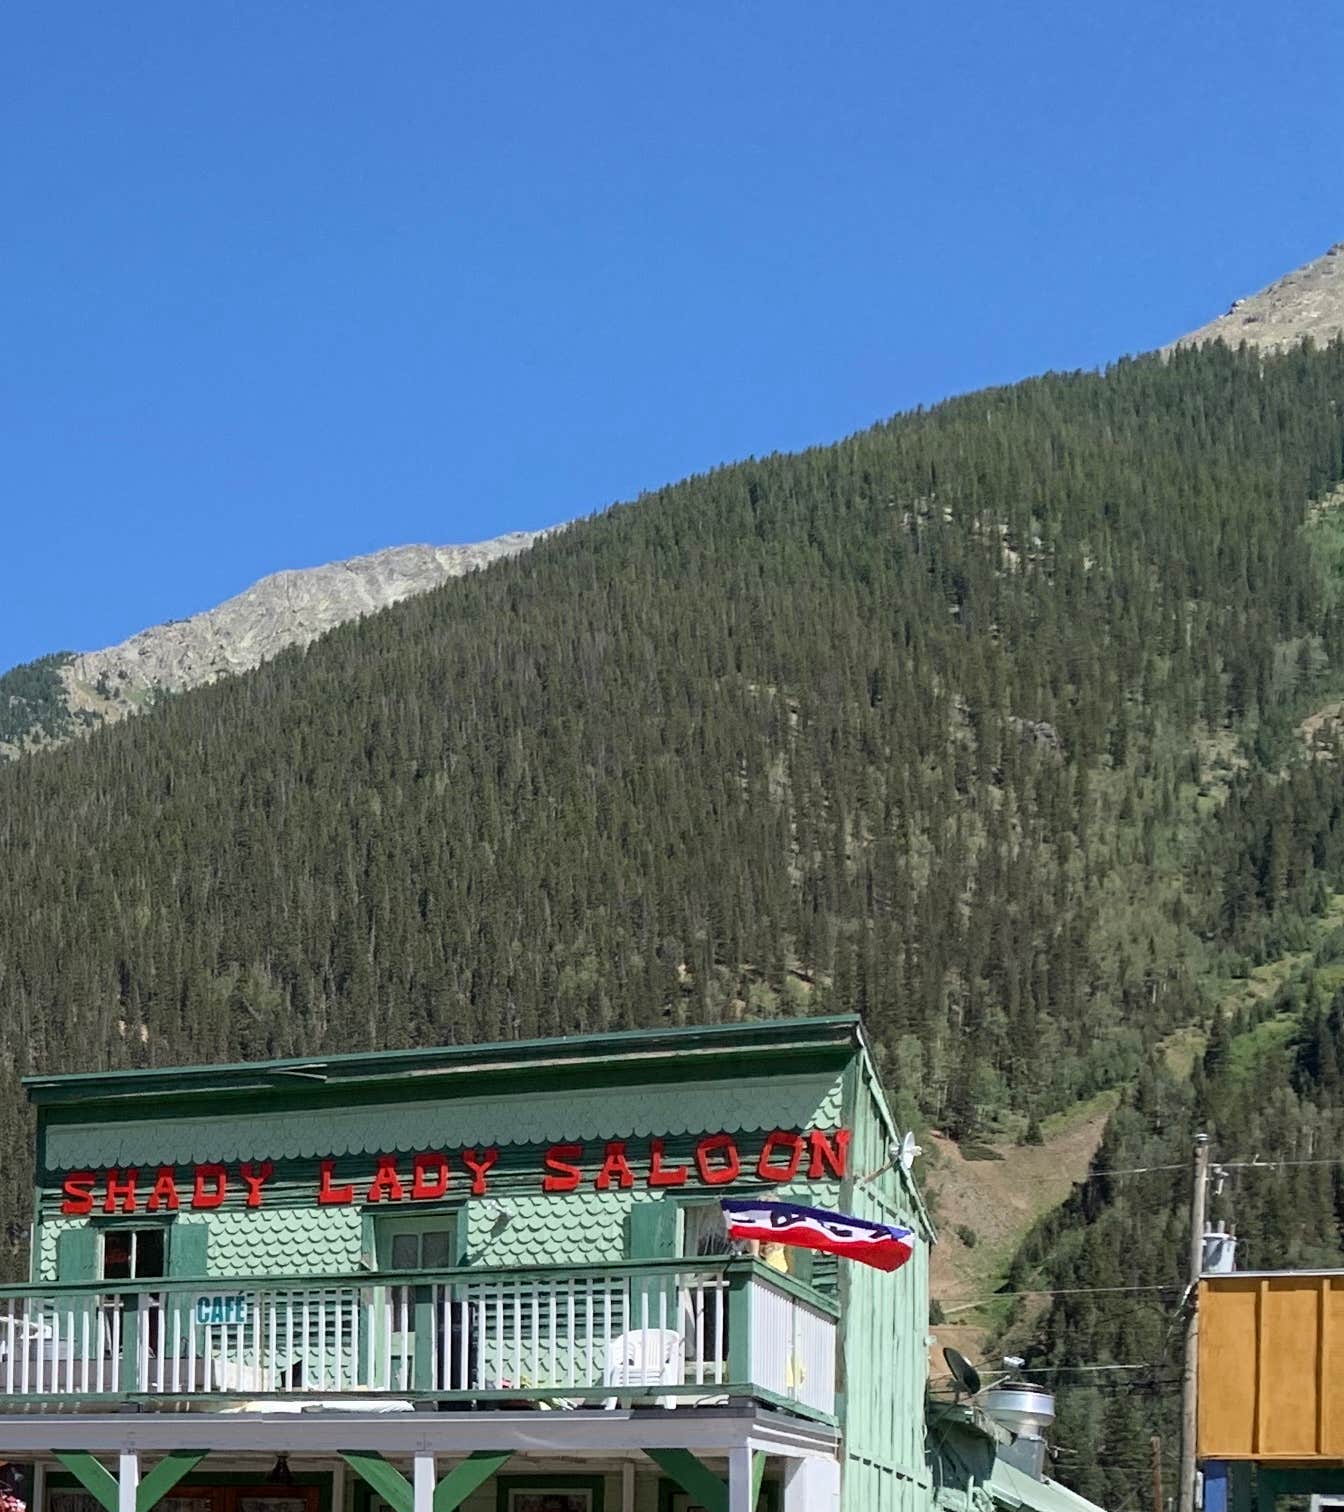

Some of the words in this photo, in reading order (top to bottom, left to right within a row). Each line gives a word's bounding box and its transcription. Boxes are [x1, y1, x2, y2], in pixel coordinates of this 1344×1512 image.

[61, 1162, 274, 1213] SHADY
[318, 1147, 500, 1204] LADY
[543, 1128, 853, 1191] SALOON
[197, 1289, 245, 1323] CAFÉ
